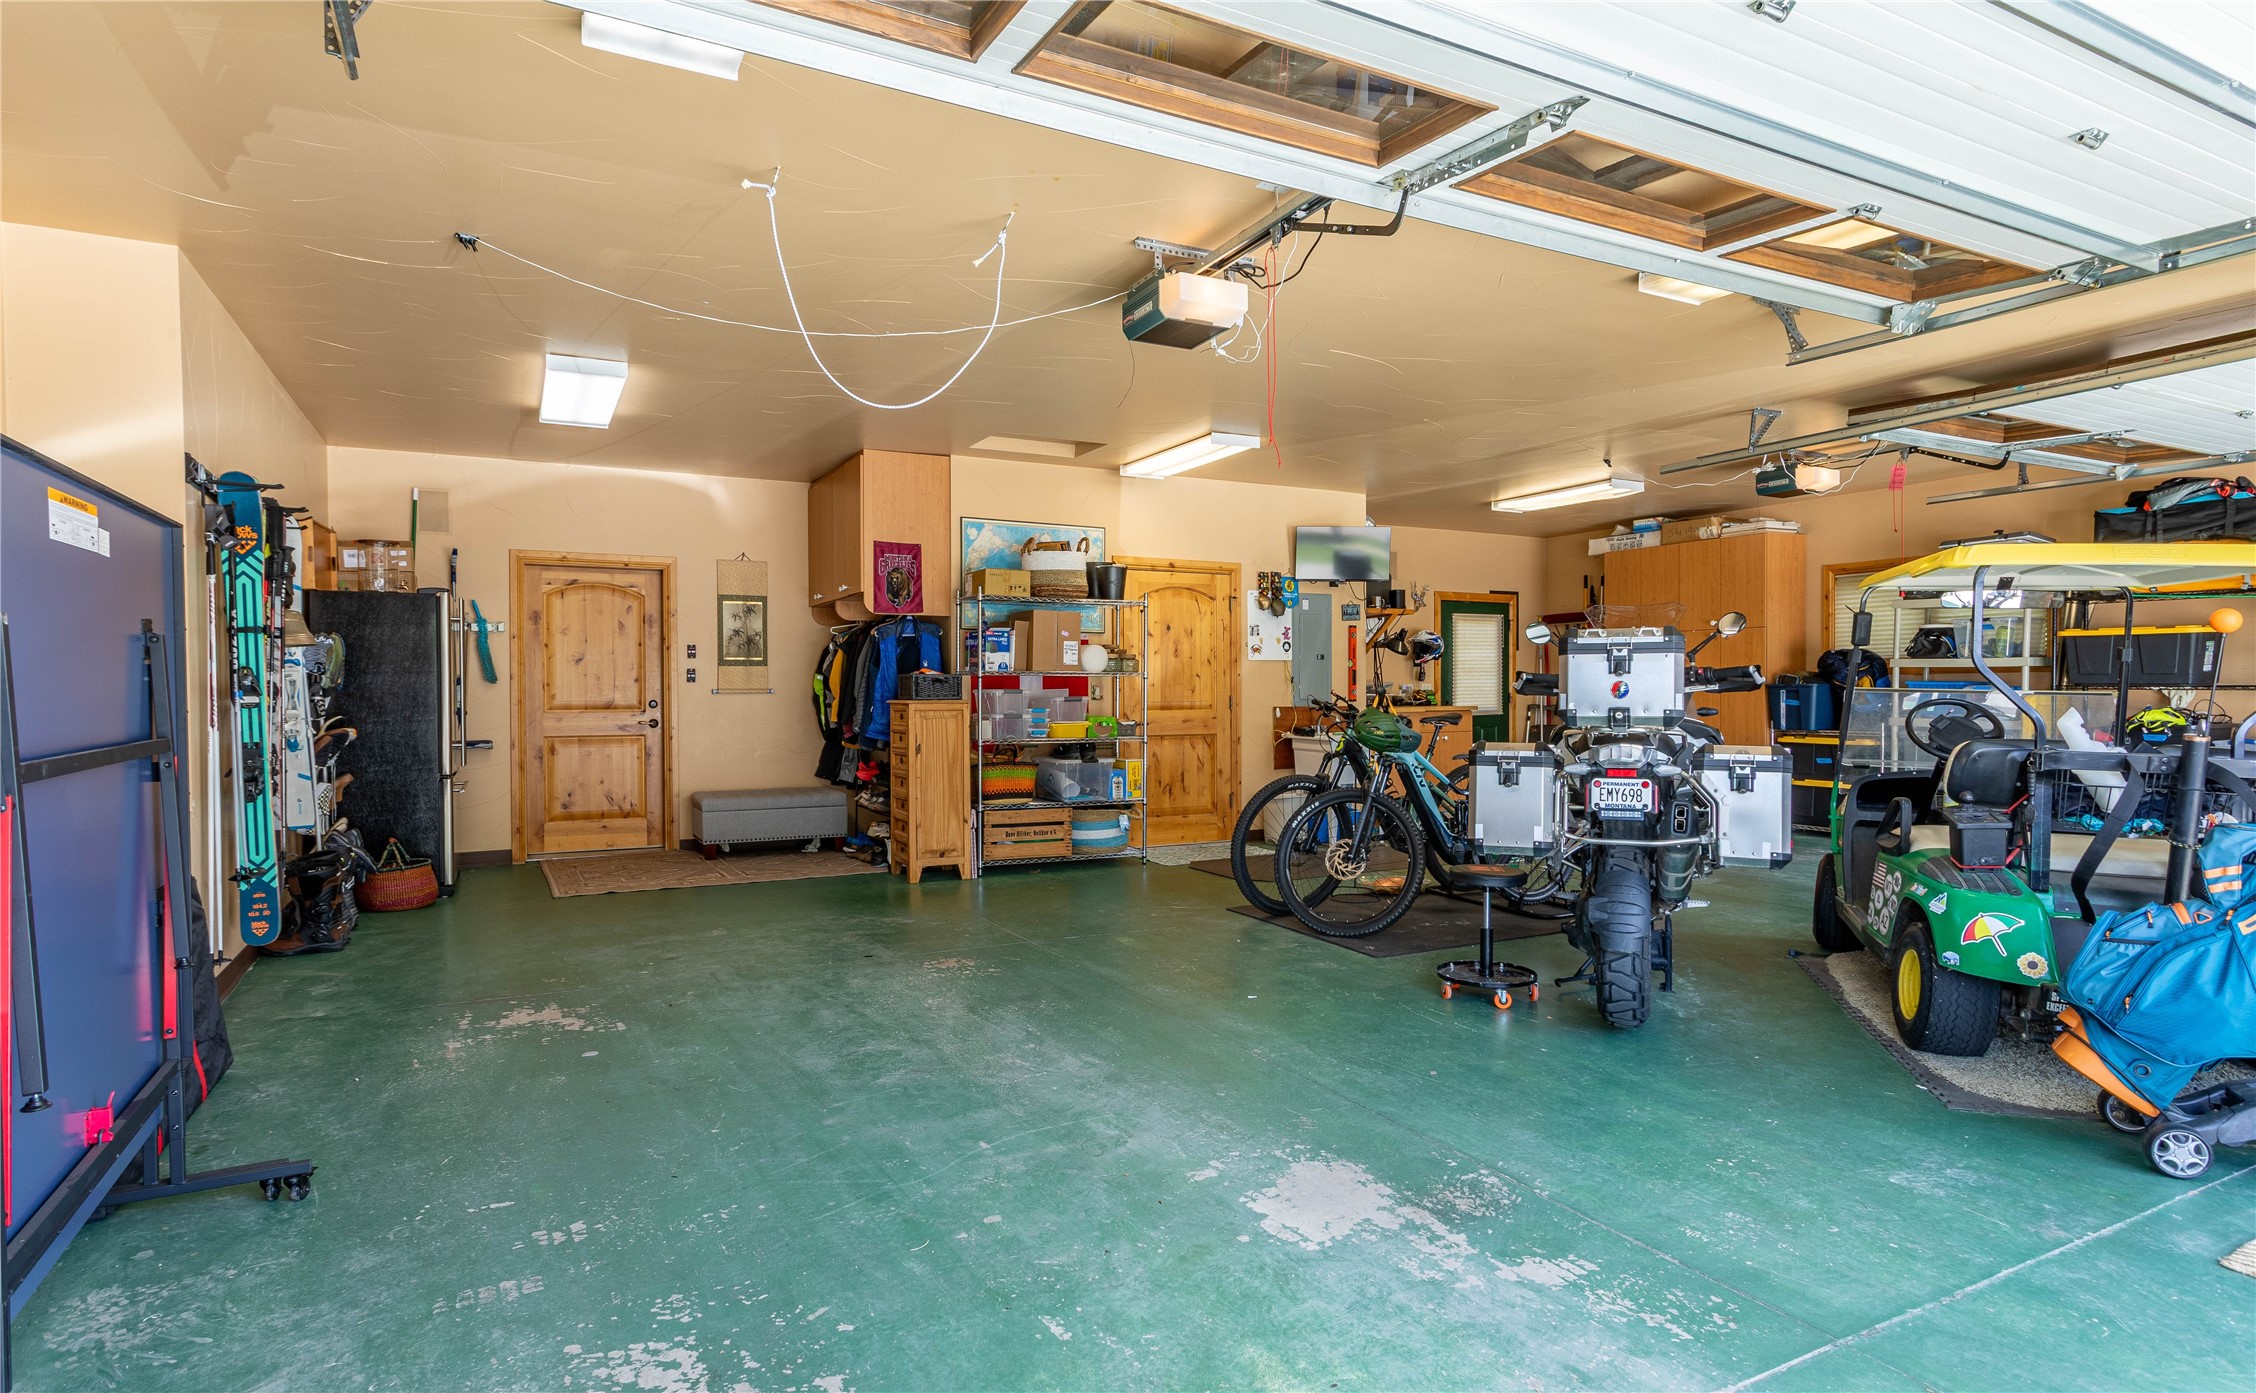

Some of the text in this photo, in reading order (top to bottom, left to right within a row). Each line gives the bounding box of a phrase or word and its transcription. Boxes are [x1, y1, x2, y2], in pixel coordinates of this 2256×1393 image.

[63, 495, 88, 512] WARNING
[1600, 788, 1642, 802] EMY698
[1291, 801, 1320, 828] MAXXIS
